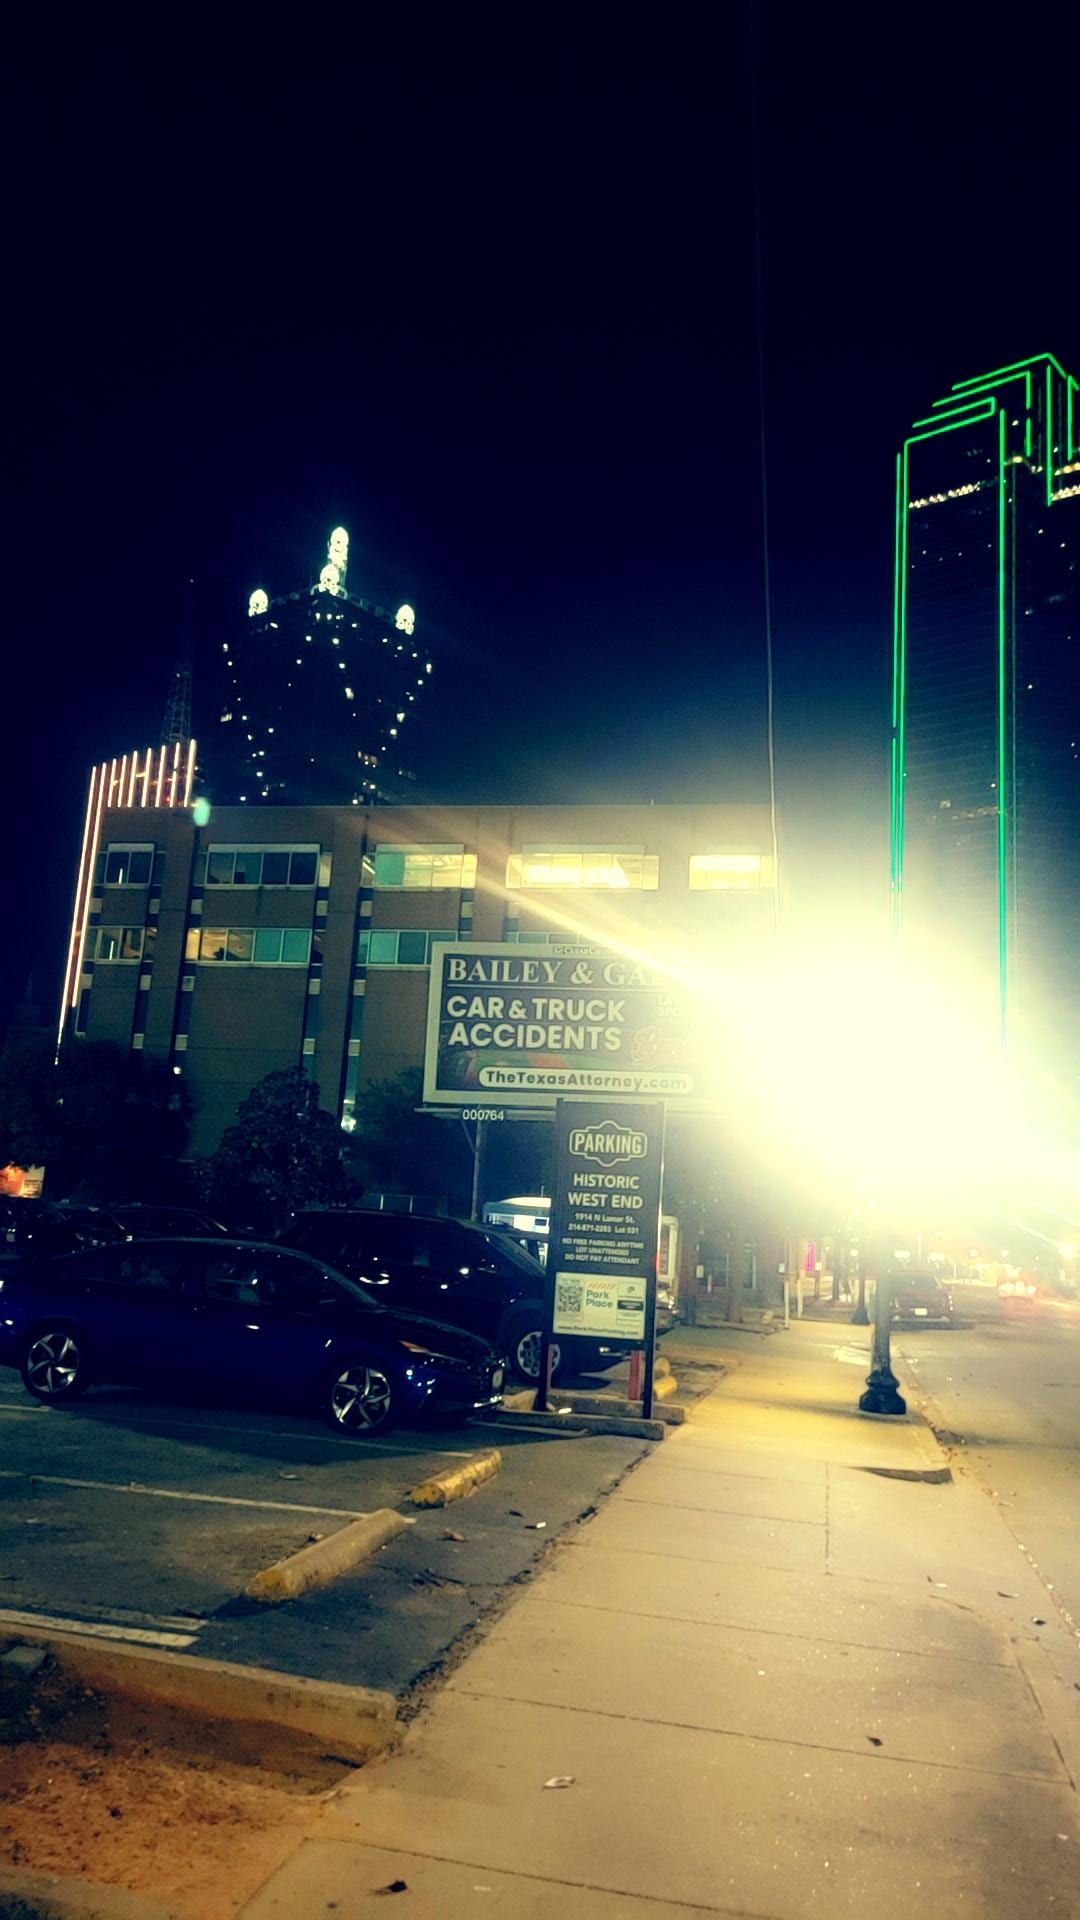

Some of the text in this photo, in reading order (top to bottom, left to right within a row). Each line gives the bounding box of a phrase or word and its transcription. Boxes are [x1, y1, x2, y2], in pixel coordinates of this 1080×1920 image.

[447, 958, 565, 984] BAILEY
[570, 961, 594, 985] &
[447, 995, 626, 1023] CAR & TRUCK
[448, 1022, 622, 1051] ACCIDENTS
[486, 1070, 688, 1092] TheTexasAttorney.com
[462, 1109, 504, 1121] 000764
[574, 1133, 642, 1154] PARKING
[573, 1173, 640, 1189] HISTORIC
[568, 1192, 643, 1209] WEST END
[594, 1214, 601, 1222] N
[589, 1239, 616, 1247] PARKING
[603, 1256, 640, 1264] ATTENDANT
[587, 1290, 610, 1299] Park
[586, 1298, 614, 1309] Place
